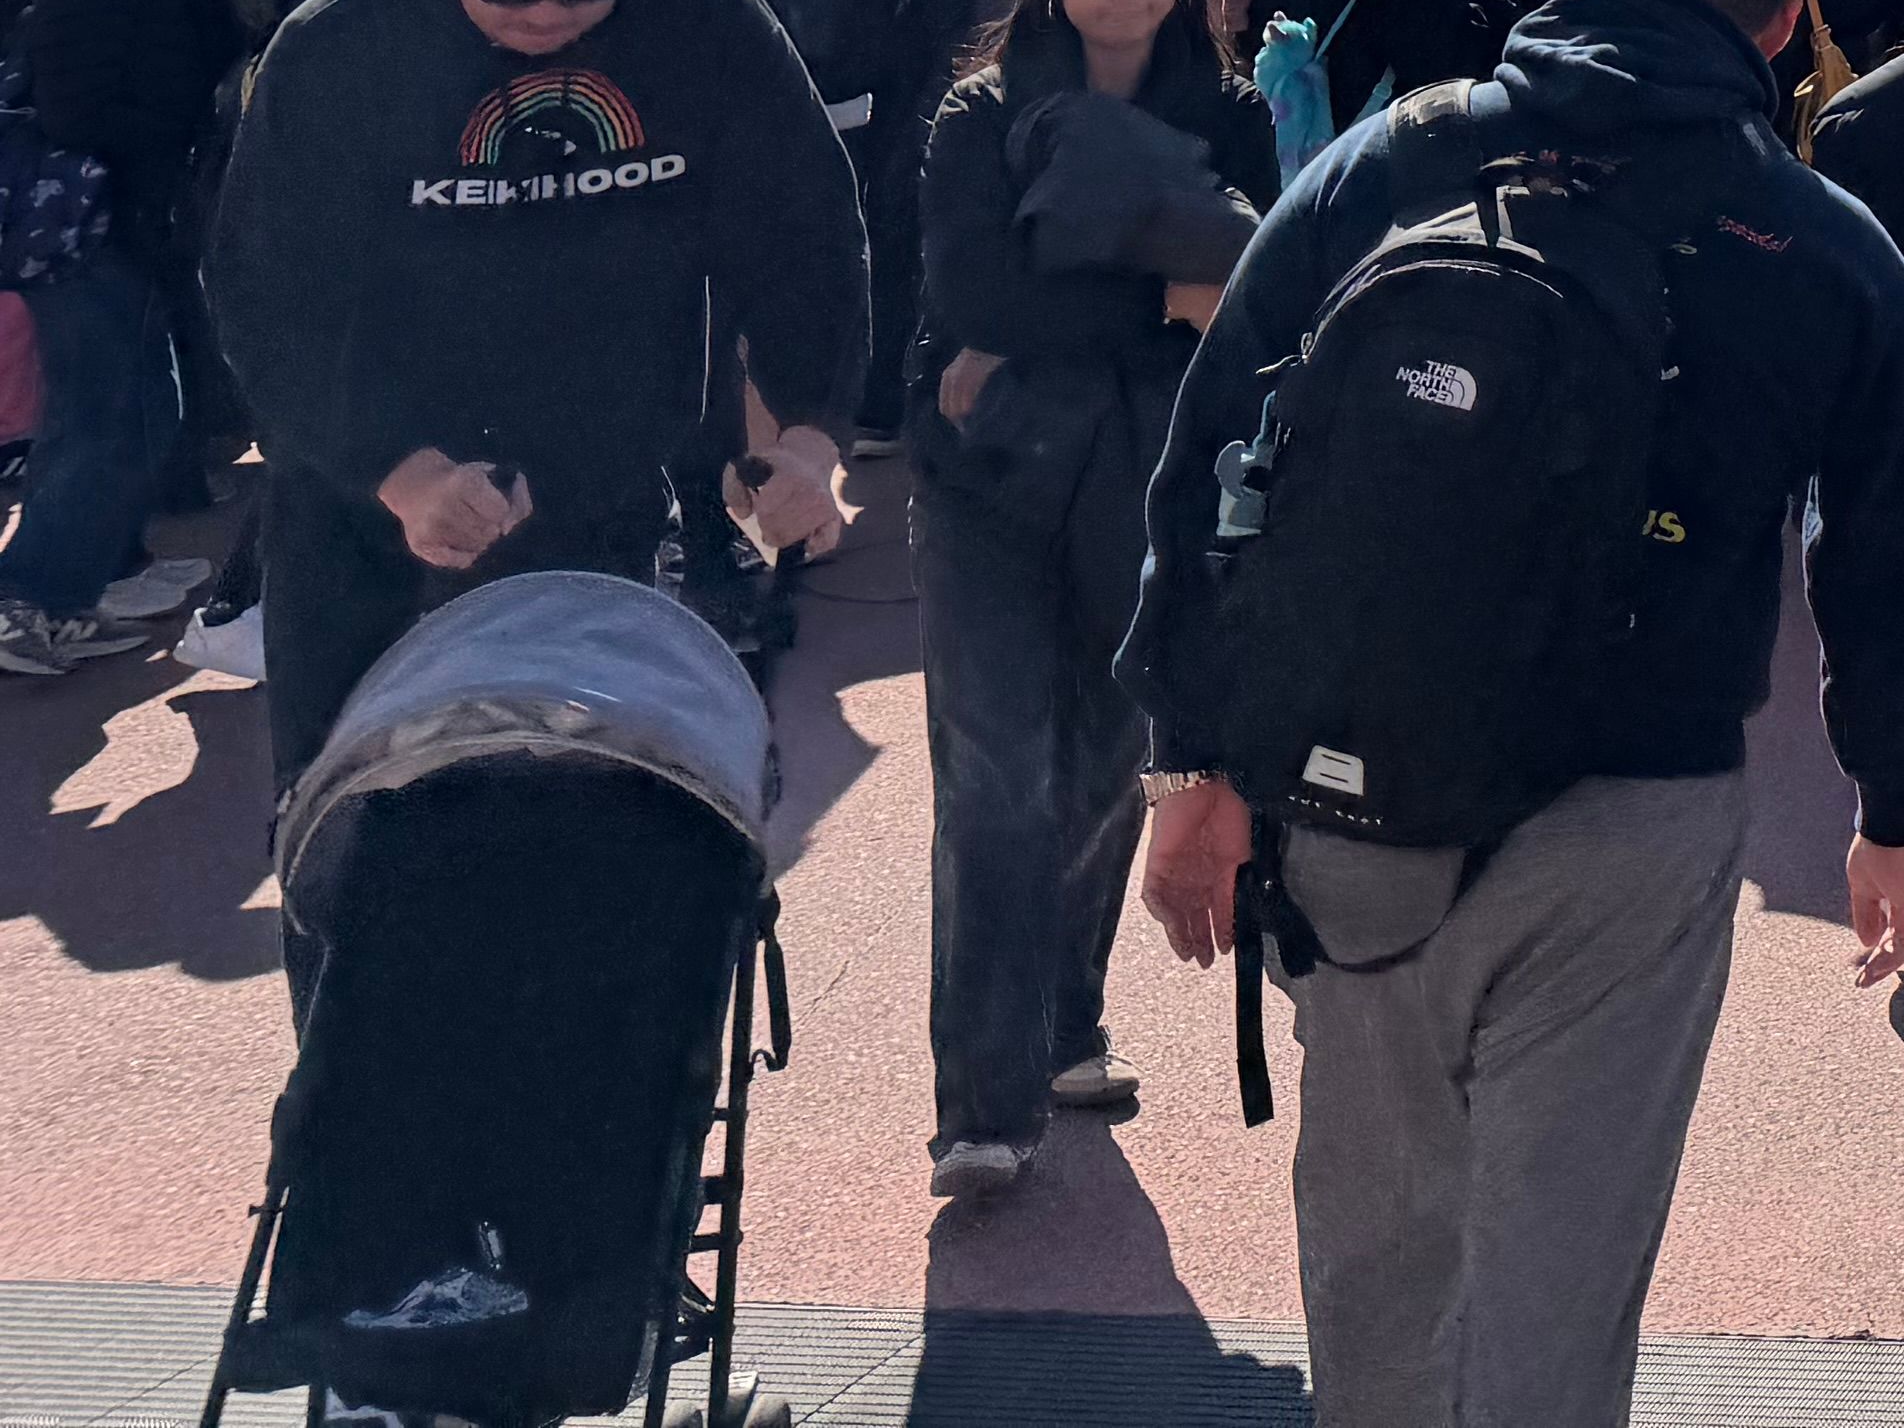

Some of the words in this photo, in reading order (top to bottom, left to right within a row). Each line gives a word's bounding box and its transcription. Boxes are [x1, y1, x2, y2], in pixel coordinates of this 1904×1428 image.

[1425, 359, 1457, 378] THE
[1395, 366, 1451, 392] NORTH
[1406, 383, 1449, 403] FACE
